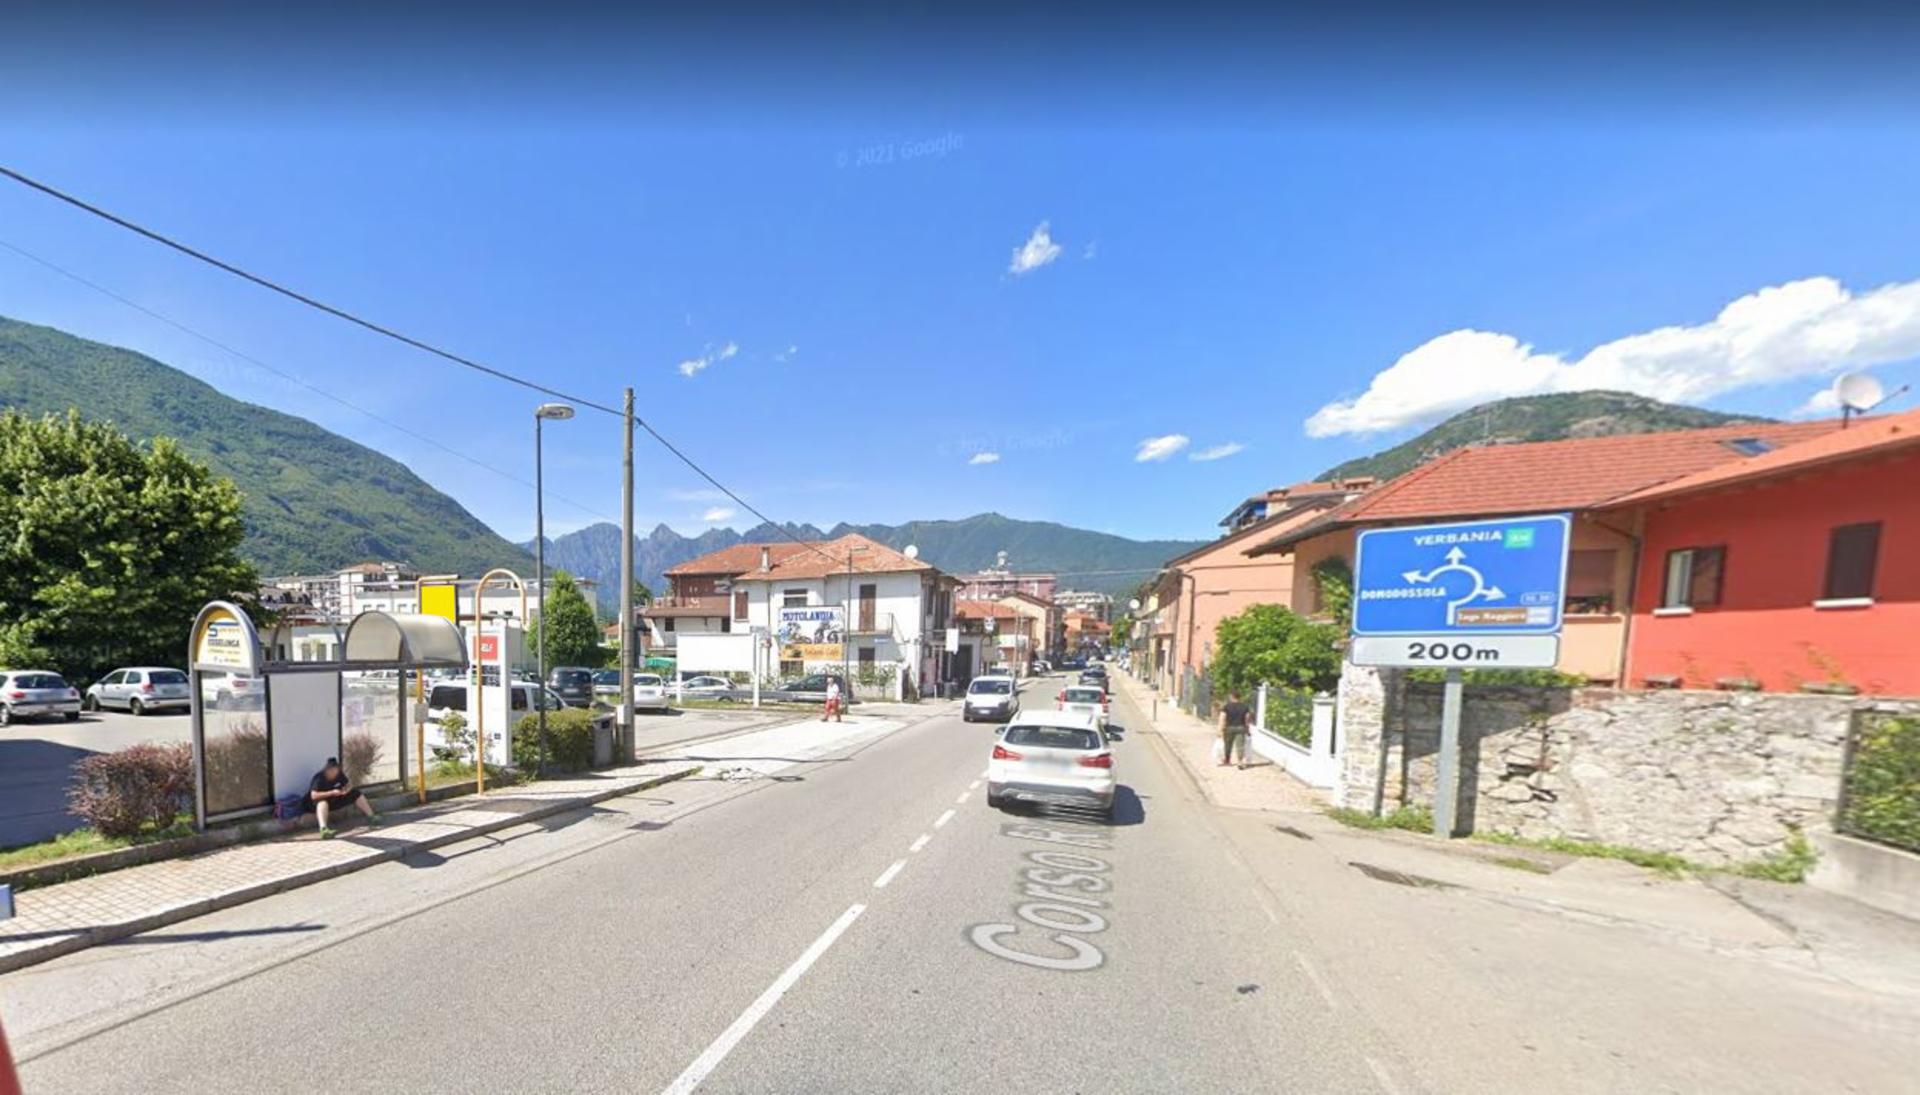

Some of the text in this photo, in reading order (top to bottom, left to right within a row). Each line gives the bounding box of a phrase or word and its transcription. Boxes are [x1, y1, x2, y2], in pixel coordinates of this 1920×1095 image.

[1414, 531, 1502, 548] VERBANIA
[1361, 587, 1447, 600] DOMODOSSOLA
[1408, 642, 1500, 661] 200m
